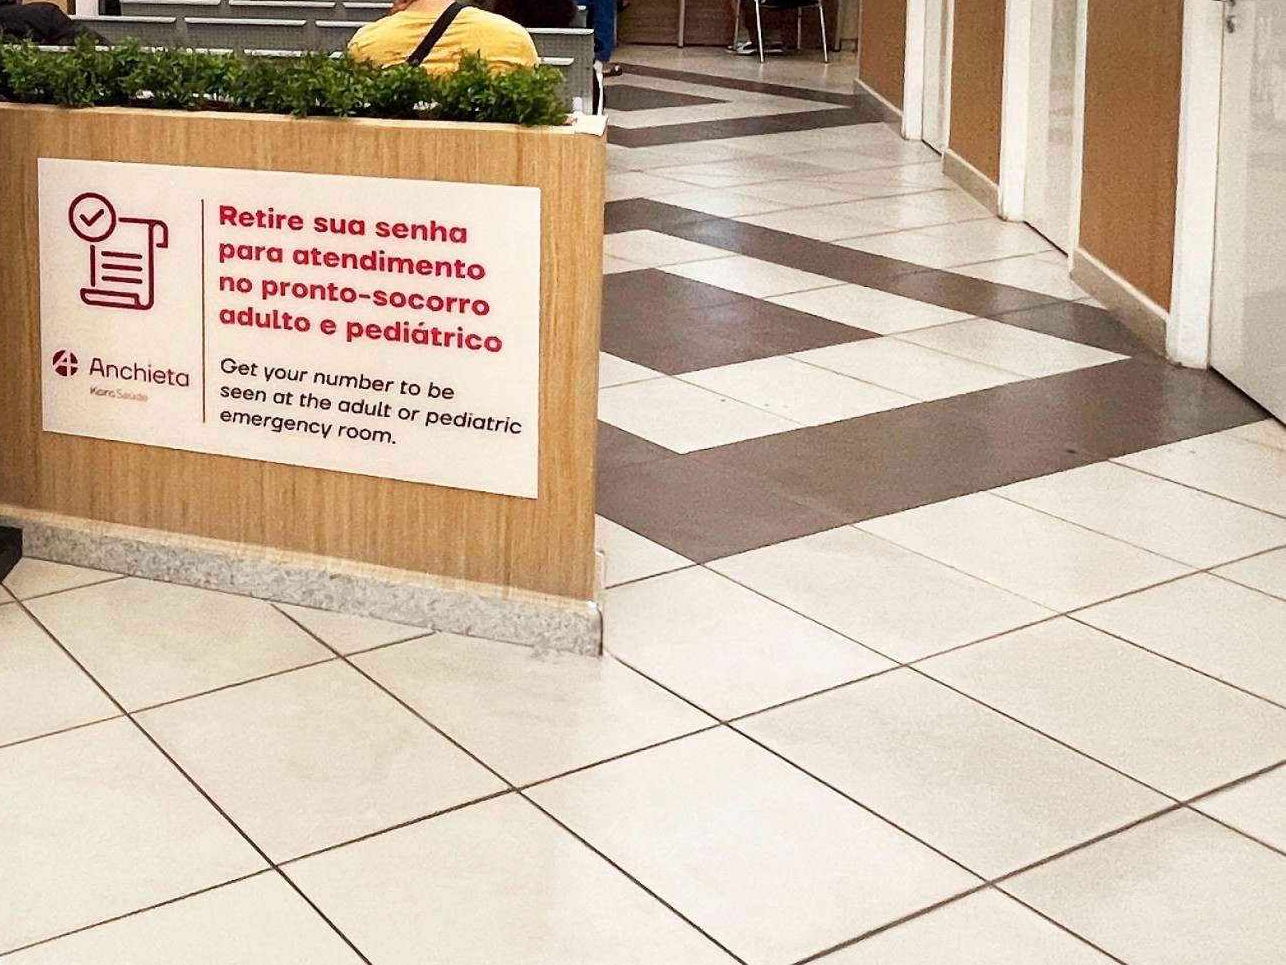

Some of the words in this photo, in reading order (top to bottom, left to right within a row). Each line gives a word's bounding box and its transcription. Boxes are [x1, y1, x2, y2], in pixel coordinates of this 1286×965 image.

[219, 204, 304, 231] Retire
[314, 217, 365, 236] sua
[375, 220, 467, 244] senha
[219, 242, 283, 264] para
[292, 247, 486, 280] atendimento
[219, 276, 253, 293] no
[262, 279, 490, 316] pronto-socorro
[219, 306, 311, 332] adulto
[320, 318, 337, 335] e
[346, 320, 503, 353] pediátrico
[89, 357, 189, 387] Anchieta
[220, 357, 258, 376] Get
[264, 366, 308, 382] your
[314, 372, 394, 392] number
[400, 380, 421, 396] to
[428, 382, 455, 399] be
[220, 385, 267, 402] seen
[273, 391, 293, 406] at
[299, 393, 332, 410] the
[338, 399, 392, 418] adult
[398, 407, 420, 421] or
[425, 411, 523, 434] pediatric
[220, 410, 332, 439] emergency
[338, 424, 396, 445] room.
